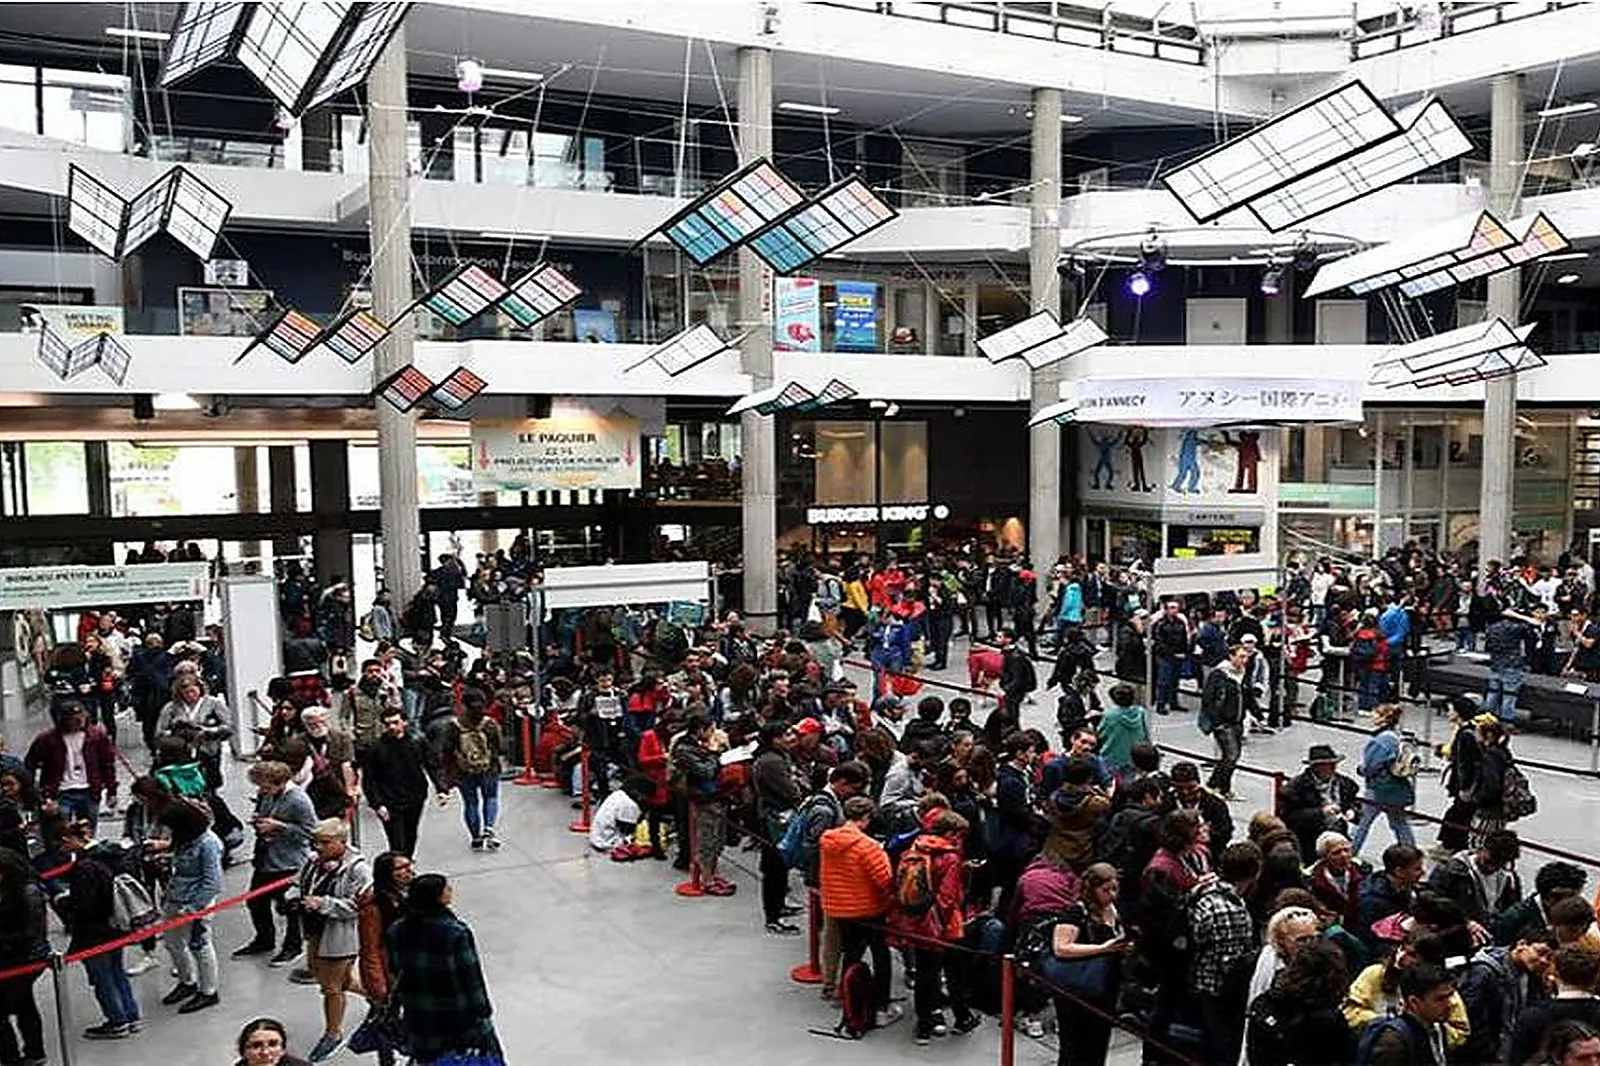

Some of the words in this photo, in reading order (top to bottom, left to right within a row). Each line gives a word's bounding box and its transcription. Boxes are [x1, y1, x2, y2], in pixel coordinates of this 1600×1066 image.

[518, 432, 533, 444] LE
[539, 432, 598, 444] PAQUIER
[807, 507, 879, 524] BURGER
[881, 505, 929, 522] KING
[95, 570, 125, 580] SALLE
